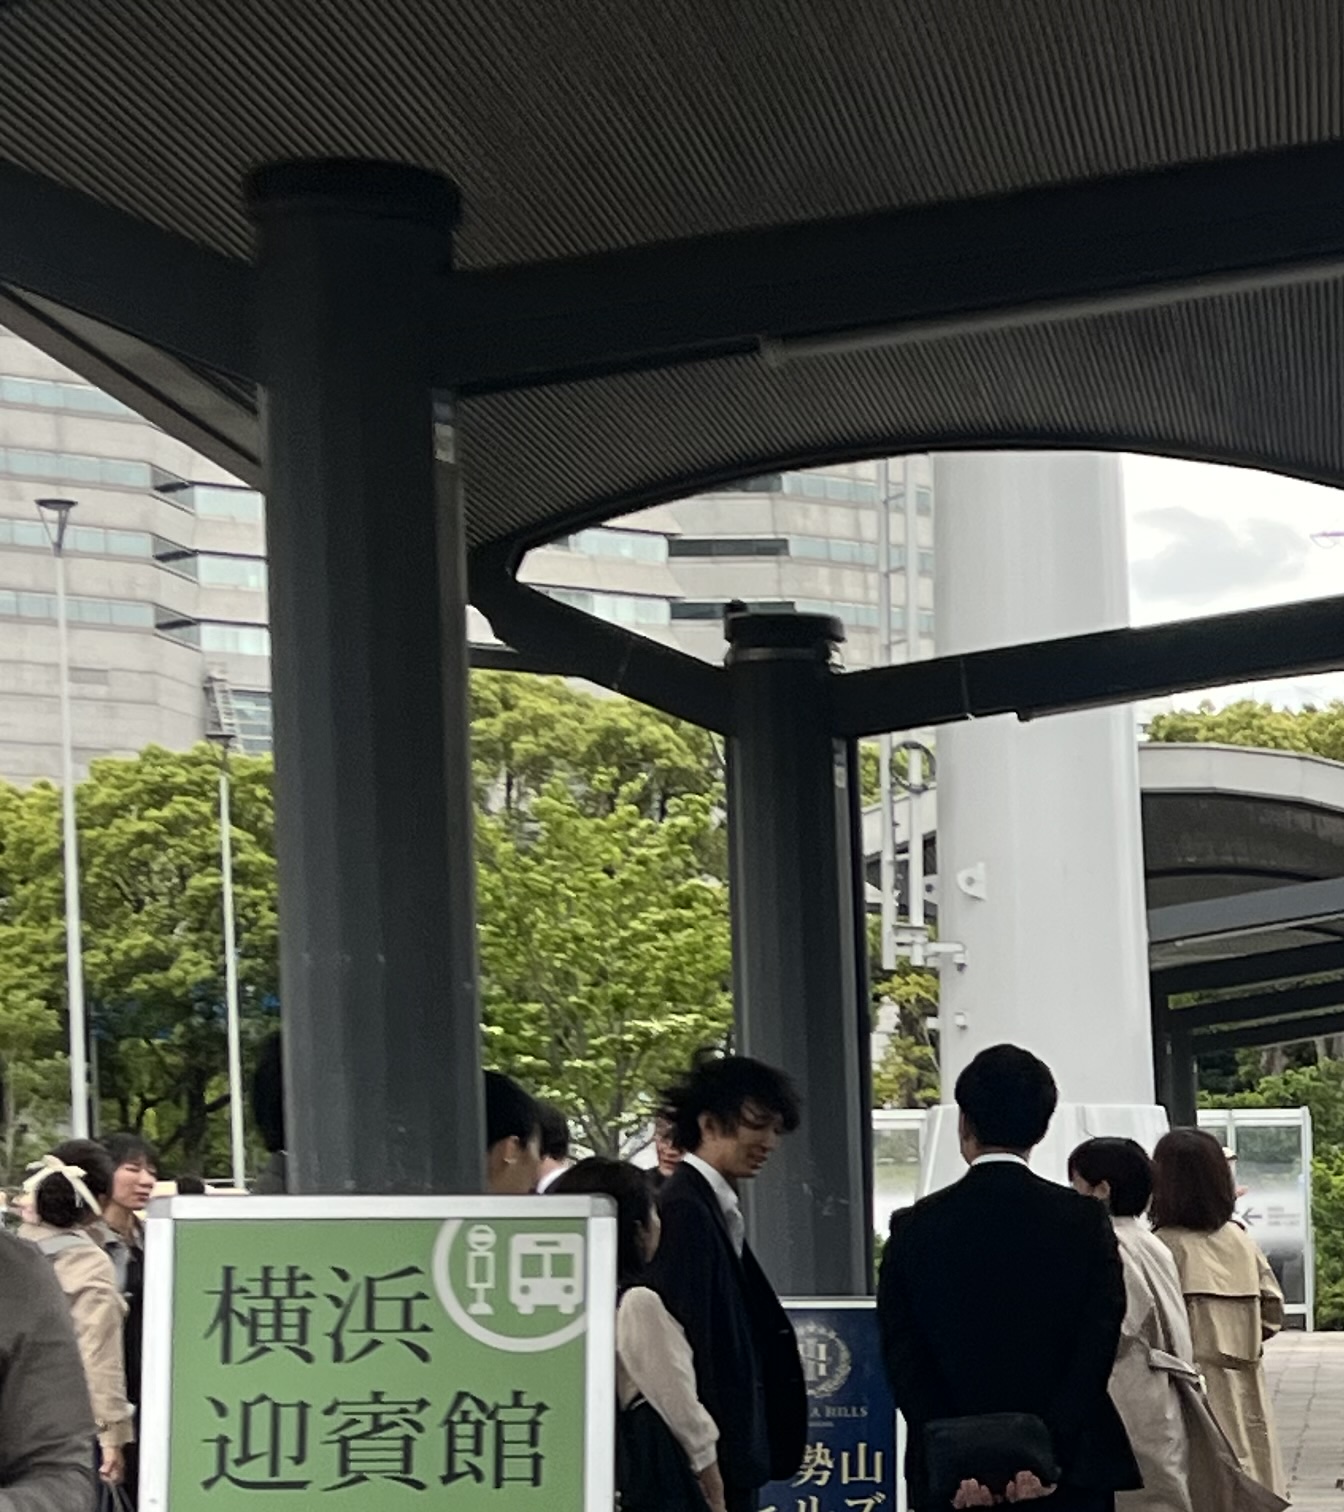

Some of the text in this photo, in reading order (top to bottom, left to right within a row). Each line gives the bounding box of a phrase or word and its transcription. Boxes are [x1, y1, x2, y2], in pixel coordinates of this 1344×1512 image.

[204, 1265, 432, 1366] 横浜
[200, 1390, 547, 1492] 迎賓館
[790, 1442, 884, 1488] 勢山
